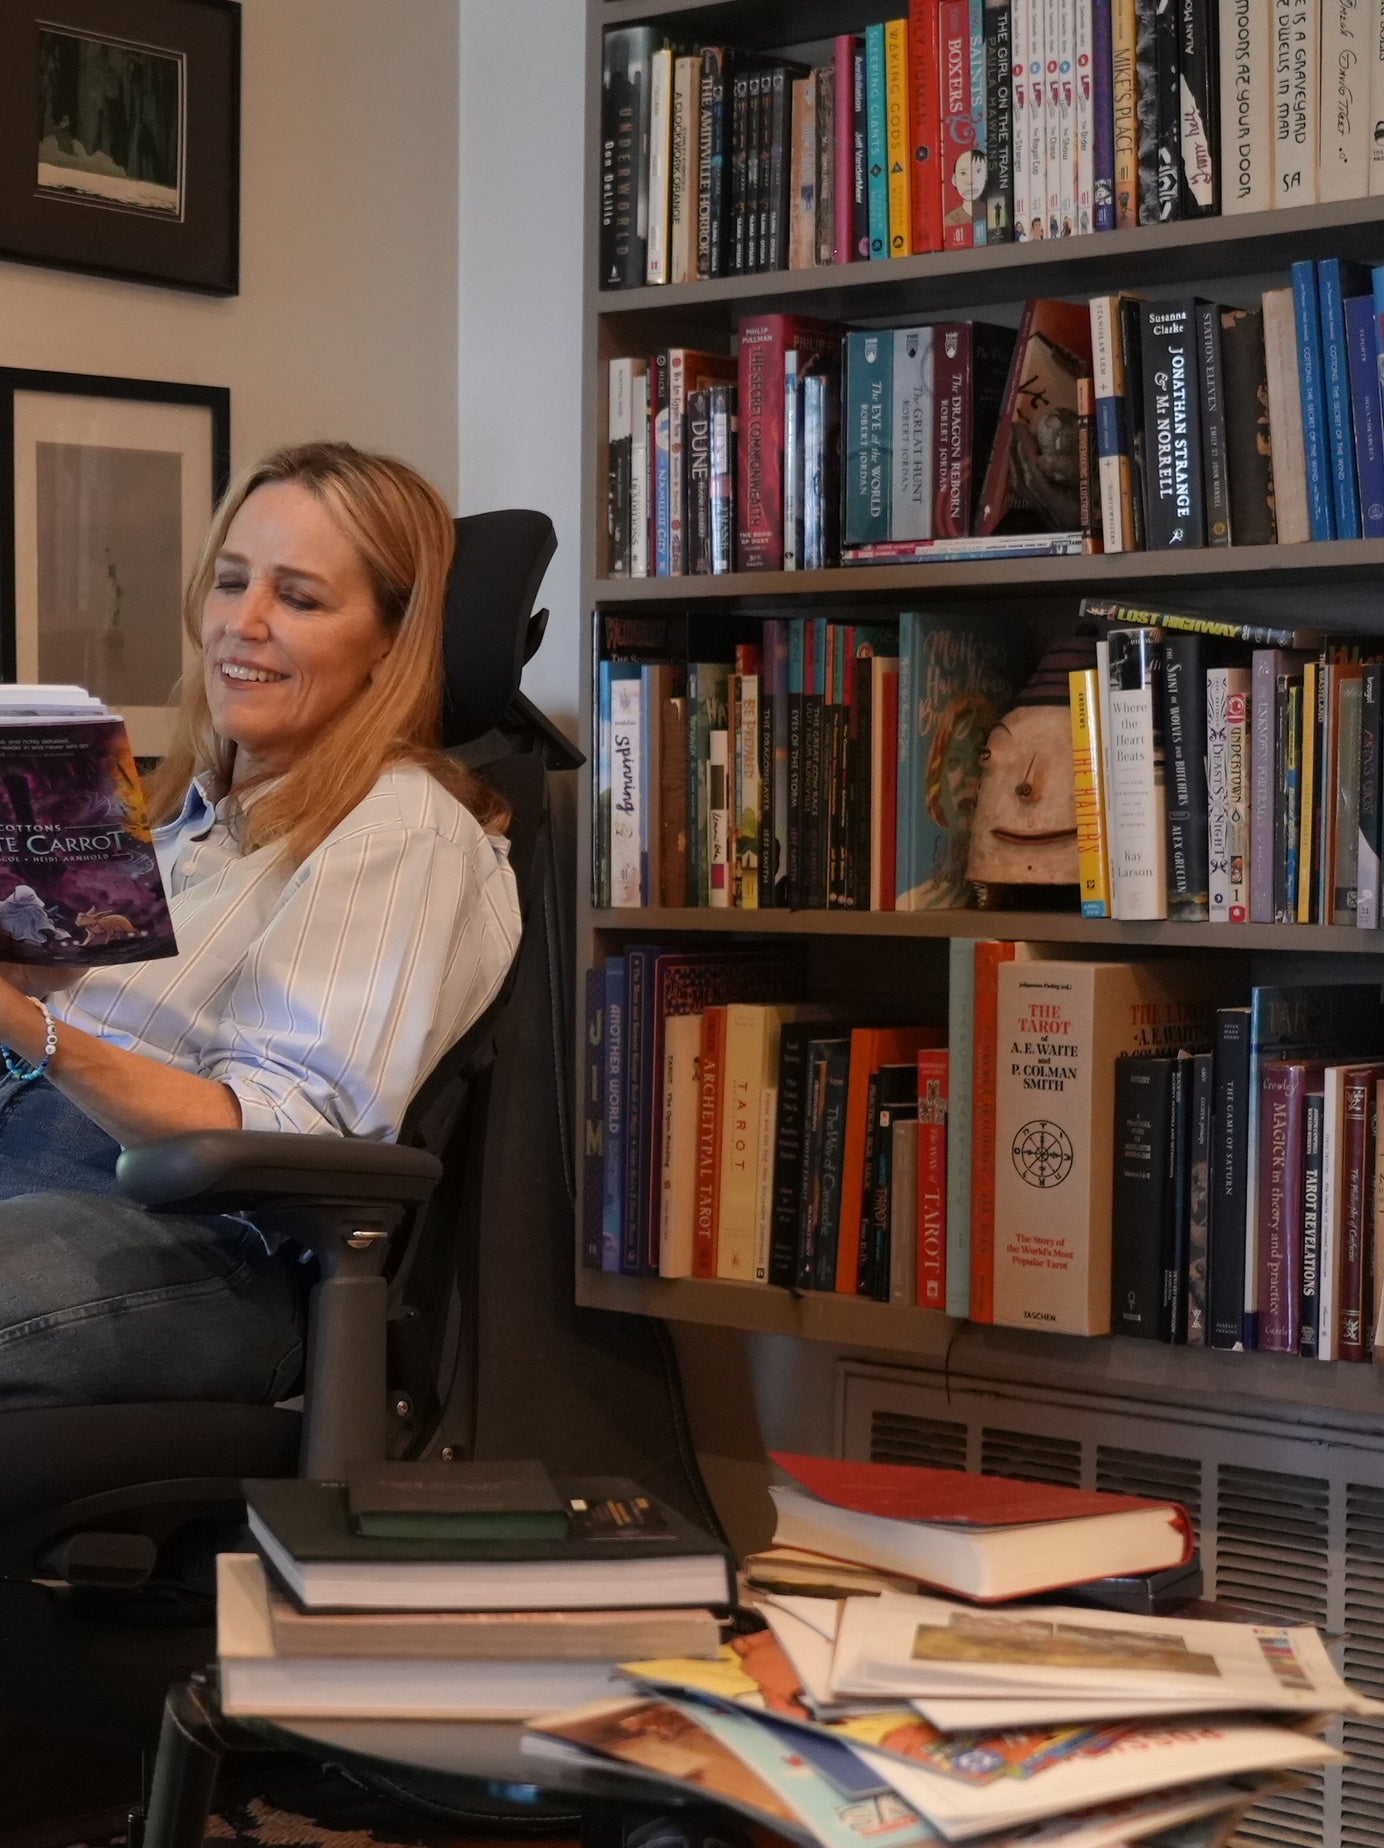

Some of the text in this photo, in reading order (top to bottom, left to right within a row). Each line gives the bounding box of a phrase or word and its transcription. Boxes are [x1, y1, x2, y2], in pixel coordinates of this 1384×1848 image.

[970, 35, 983, 108] SAINTS
[1184, 26, 1195, 55] ALAN
[855, 56, 863, 113] Annihilation
[869, 31, 881, 156] SLEEPING GIANTS
[888, 29, 902, 151] WAKING GODS
[948, 39, 963, 114] BOXERS
[997, 13, 1010, 189] THE GIRL ON THE TRAIN
[1114, 48, 1133, 156] MIKE'S PLACE
[1276, 15, 1290, 141] DWELLS IN MAN
[1292, 13, 1307, 145] IS A GRAVEYARD
[699, 76, 714, 255] THE AMITYVILLE HORROR
[1235, 90, 1252, 200] YOUR DOOR
[603, 140, 614, 226] Don DeLillo
[617, 107, 633, 255] UNDERWORLD
[742, 334, 773, 344] PULLMAN
[745, 327, 769, 336] PHILIP
[1149, 312, 1187, 324] Susanna
[1153, 323, 1184, 336] Clarke
[1099, 356, 1107, 375] LEM
[1202, 313, 1217, 413] STATION ELEVEN
[691, 420, 708, 481] DUNE
[748, 347, 763, 528] THE SECRET COMMONWEALTH
[859, 403, 868, 496] ROBERT JORDAN
[869, 380, 883, 518] The EYE of the WORLD
[901, 400, 910, 493] ROBERT JORDAN
[912, 386, 923, 505] The GREAT HUNT
[939, 399, 949, 493] ROBERT JORDAN
[950, 373, 962, 519] The DRAGON REBORN
[1154, 372, 1173, 500] & Mr NORRELL
[1168, 346, 1190, 519] JONATHAN STRANGE
[1332, 386, 1346, 480] THE SECRET THE WIND
[1117, 607, 1243, 638] LOST HIGHWAY
[812, 707, 820, 728] THE
[1078, 692, 1086, 730] ANDREWS
[1113, 702, 1148, 713] Where
[1121, 718, 1138, 728] the
[1317, 670, 1325, 723] WASTELAND
[1364, 676, 1375, 704] brosgol
[790, 709, 800, 809] EYES OF THE STORM
[812, 730, 820, 762] GREAT
[1116, 734, 1145, 746] Heart
[1117, 750, 1145, 762] Beats
[1230, 727, 1243, 804] UNDERTOWN
[615, 735, 636, 817] Spinning
[1072, 748, 1102, 854] THE HATERS
[1166, 663, 1189, 894] SAINT WOLVES BUTCHERS ALEX GRECIAN
[1212, 743, 1225, 859] BEASTS NIGHT
[26, 831, 126, 855] CARROT
[32, 855, 58, 863] HEIDI
[63, 853, 110, 862] ARNHOLD
[1117, 866, 1153, 877] Larson
[1124, 851, 1142, 863] Kay
[1018, 1018, 1071, 1035] TAROT
[1028, 1003, 1061, 1020] THE
[1041, 1035, 1049, 1043] of
[608, 1004, 622, 1134] ANOTHER WORLD
[1010, 1042, 1079, 1058] A. E. WAITE
[1011, 1063, 1078, 1079] P. COLMAN
[826, 1104, 839, 1124] The
[1023, 1078, 1064, 1092] SMITH
[1262, 1077, 1300, 1097] Crowley
[699, 1058, 716, 1240] ARCHETYPAL TAROT
[734, 1080, 748, 1171] TAROT
[1225, 1081, 1234, 1196] THE GAME OF SATURN
[1350, 1167, 1359, 1181] The
[874, 1186, 888, 1231] TAROT
[924, 1188, 941, 1274] TAROT
[1016, 1233, 1055, 1247] The Story
[1267, 1101, 1287, 1316] MAGICK in theory and practice
[1303, 1168, 1319, 1297] TAROT REVELATIONS
[1006, 1244, 1074, 1259] the Most
[1011, 1255, 1068, 1271] Popular Tarot
[1023, 1310, 1057, 1322] TASCHEN
